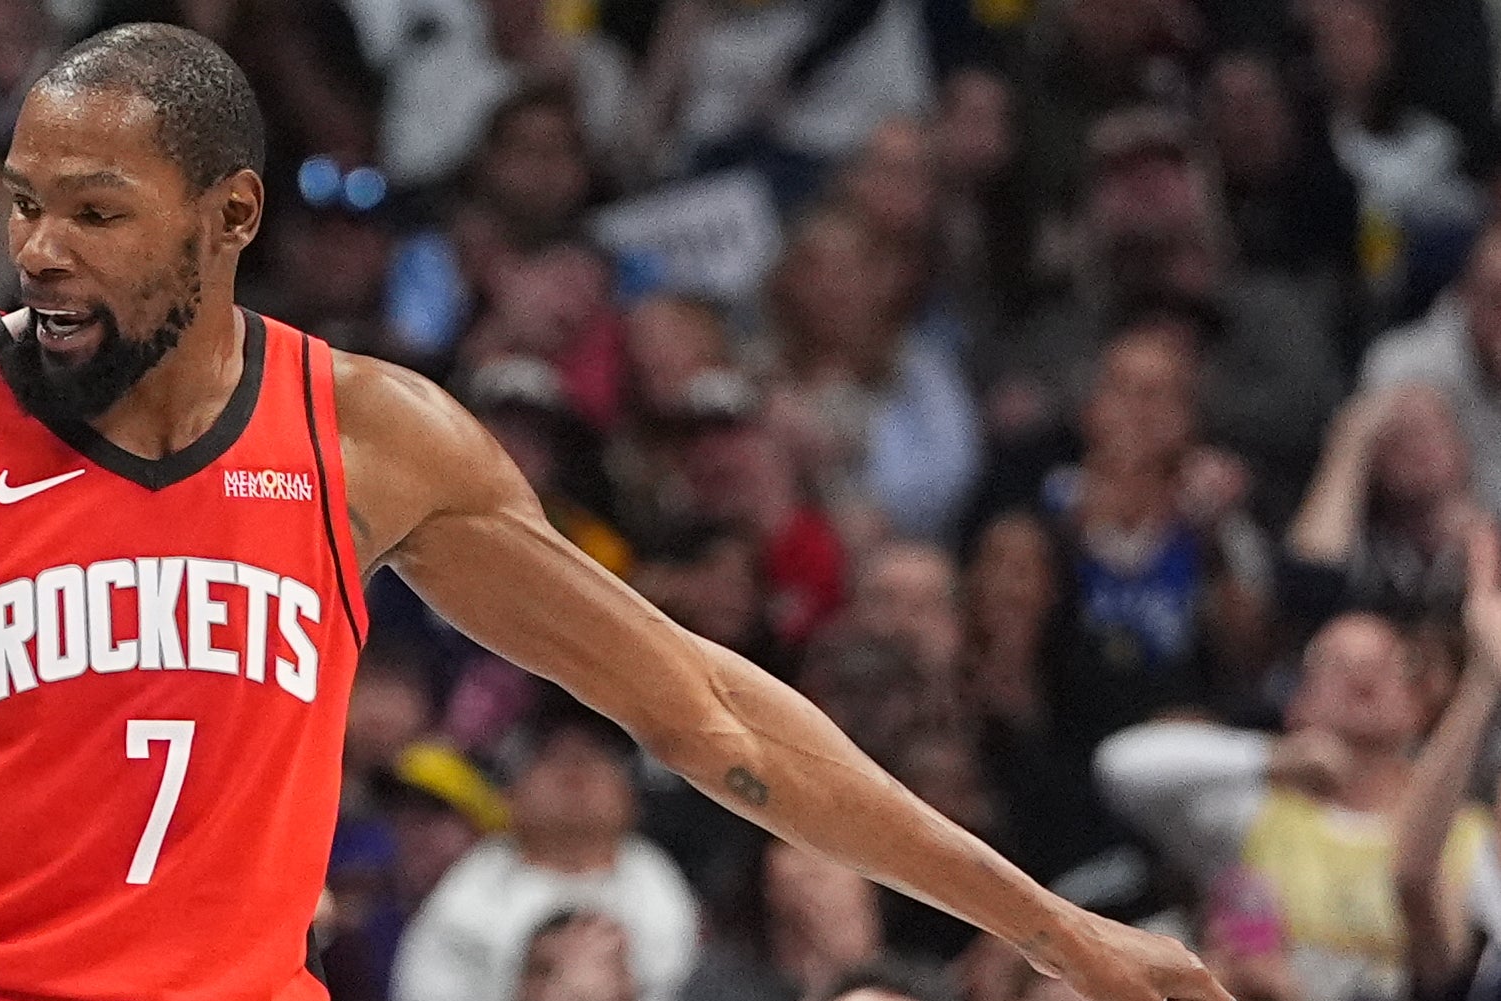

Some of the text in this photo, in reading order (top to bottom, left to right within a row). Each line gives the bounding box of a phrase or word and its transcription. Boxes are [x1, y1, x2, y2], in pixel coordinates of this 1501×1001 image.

[224, 469, 310, 490] MEMORIAL
[224, 480, 313, 501] HERMANN
[126, 719, 196, 885] 7
